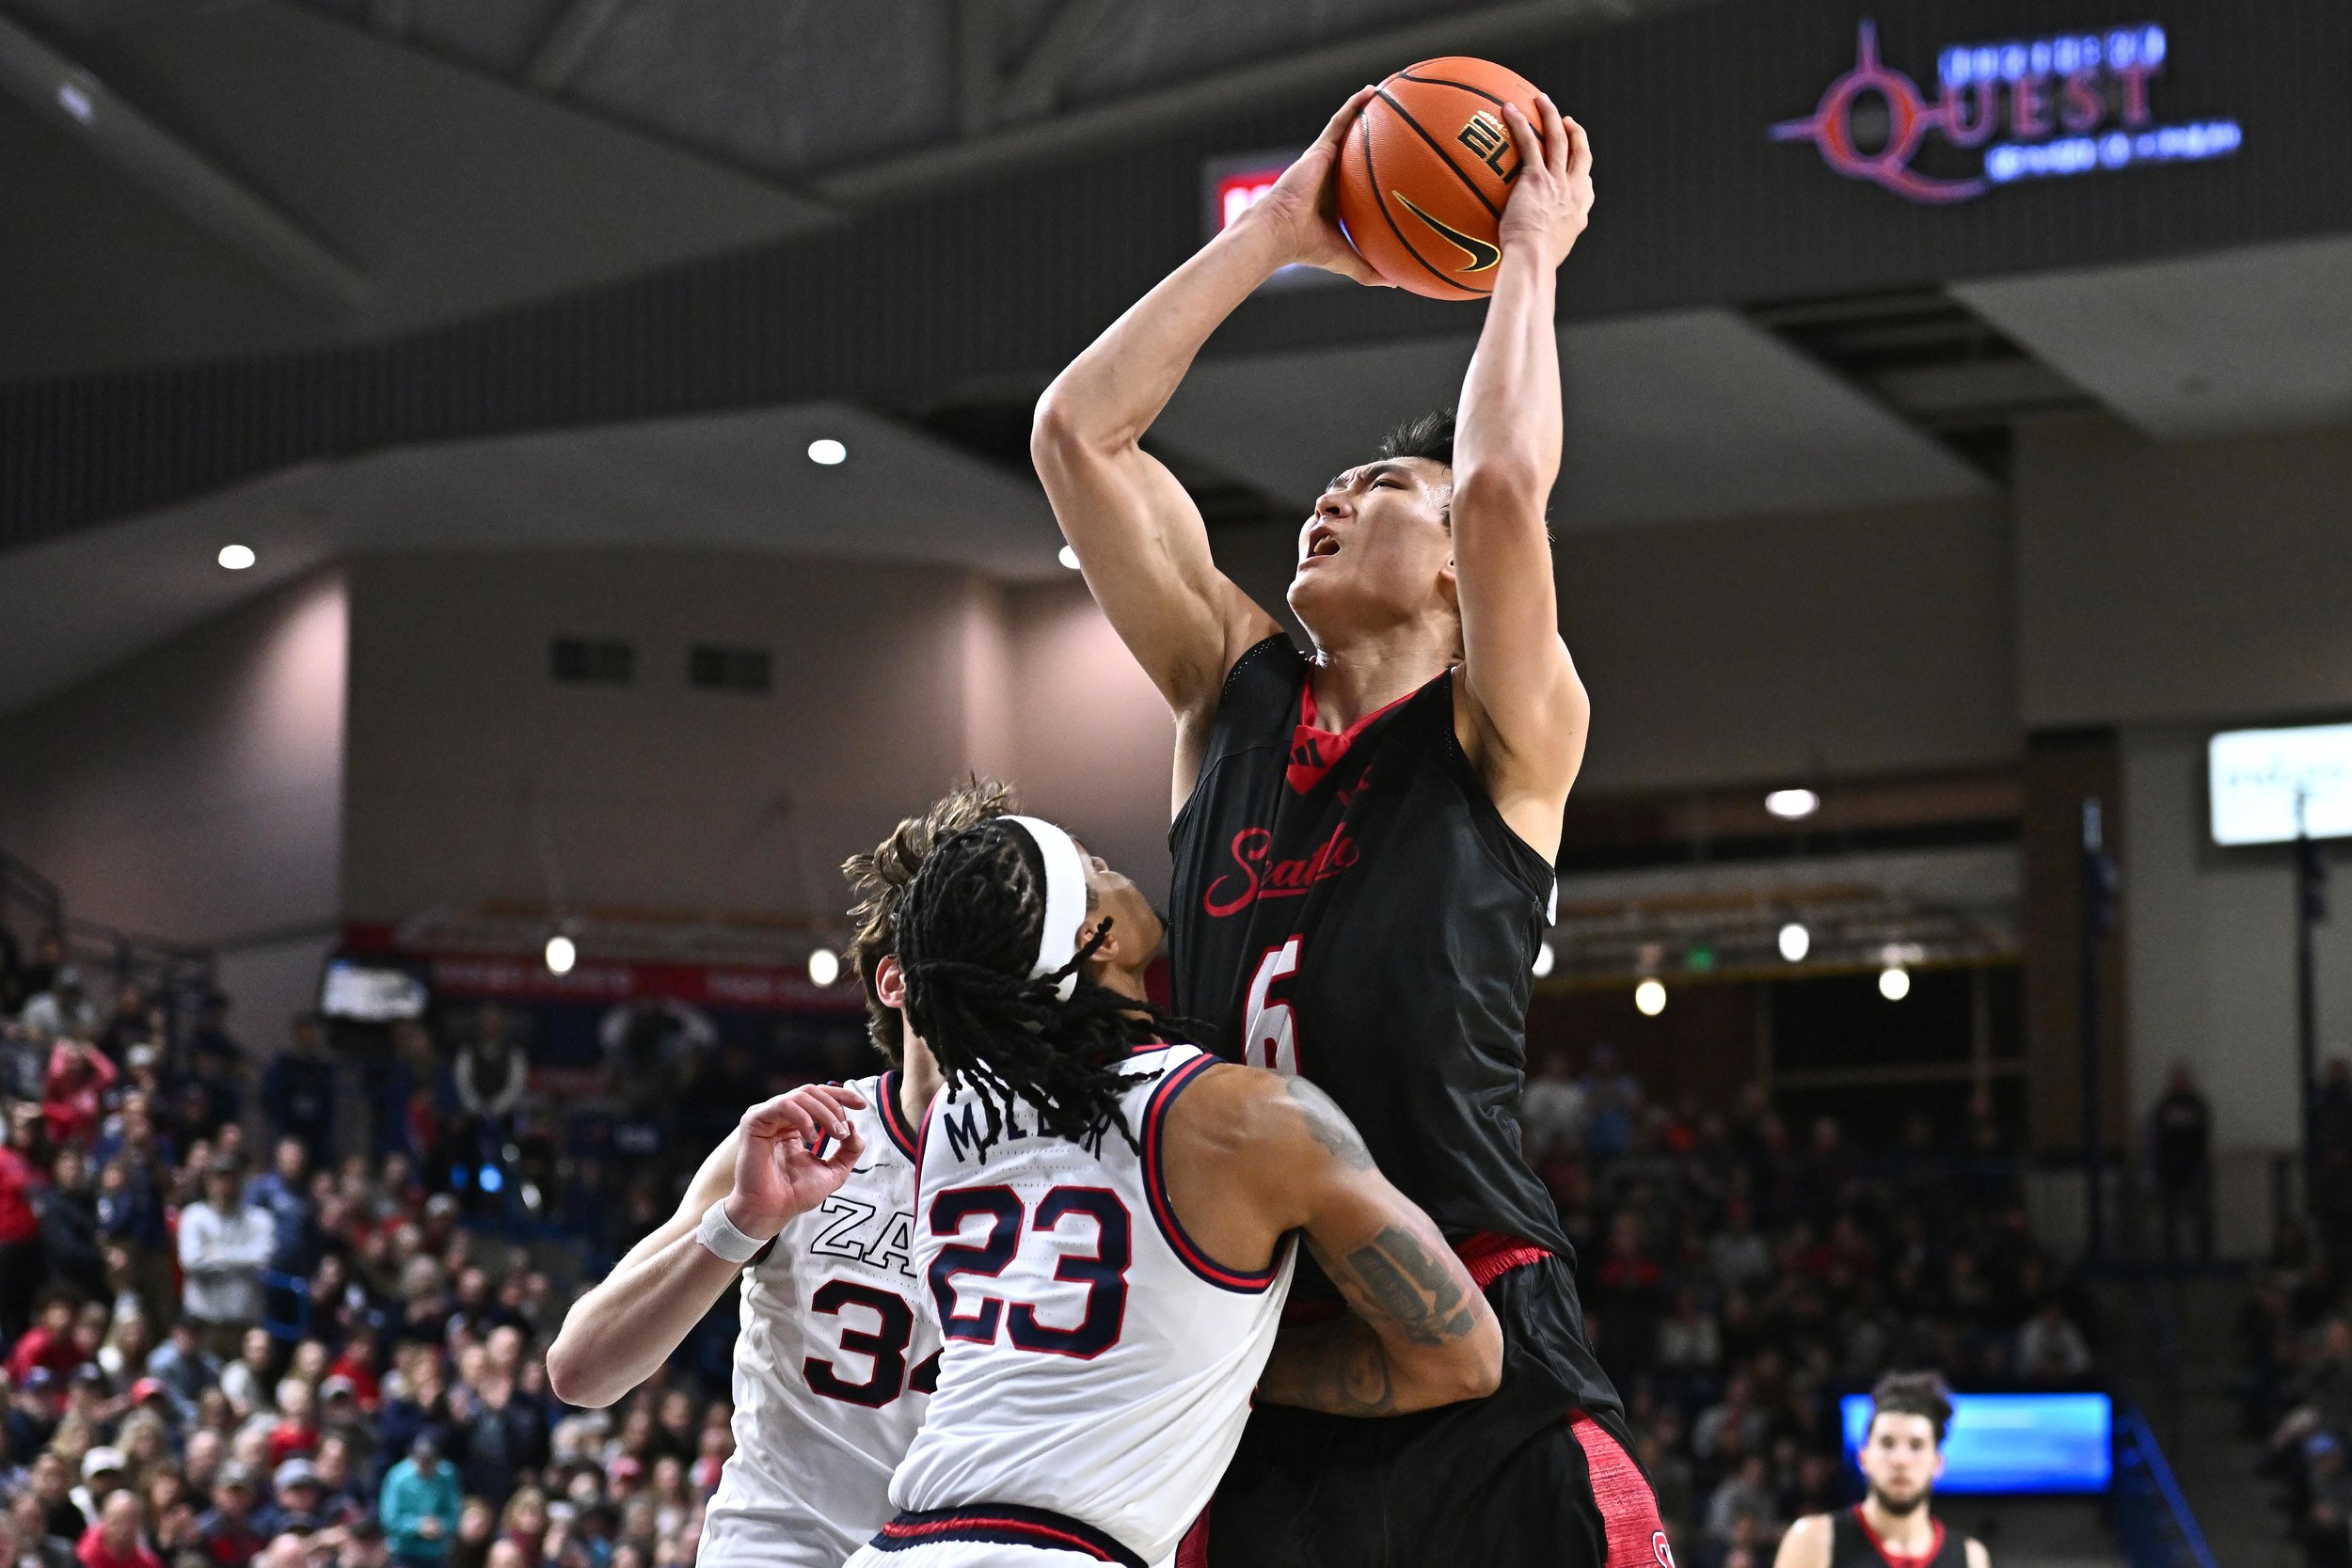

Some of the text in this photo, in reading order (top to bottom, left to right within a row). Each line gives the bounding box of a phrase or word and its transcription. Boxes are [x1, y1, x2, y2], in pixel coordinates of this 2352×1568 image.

[1242, 933, 1303, 1076] 6
[944, 1102, 1113, 1162] MLLR
[928, 1184, 1132, 1361] 23
